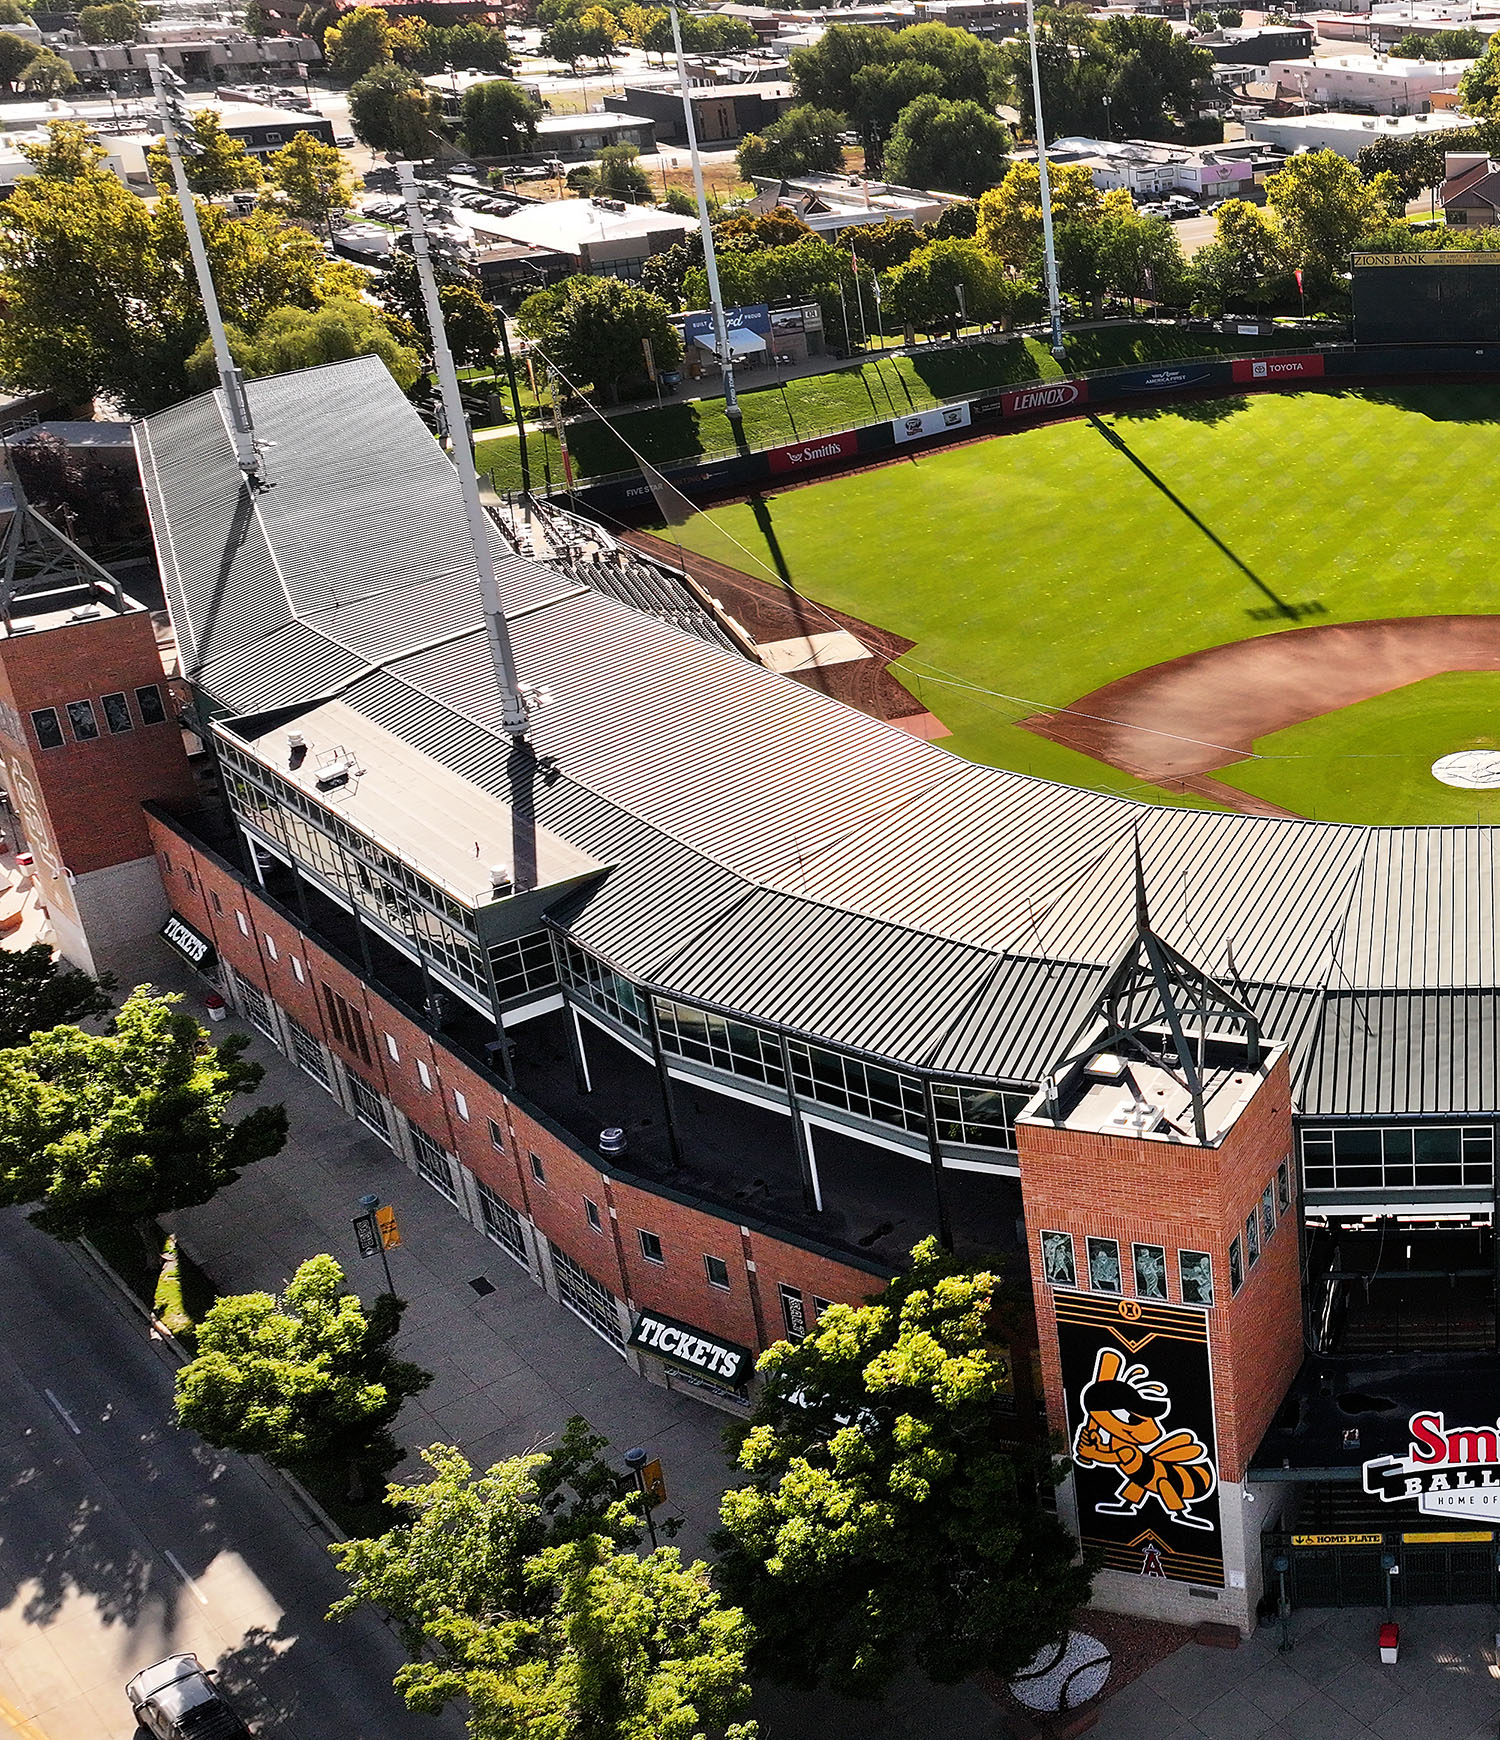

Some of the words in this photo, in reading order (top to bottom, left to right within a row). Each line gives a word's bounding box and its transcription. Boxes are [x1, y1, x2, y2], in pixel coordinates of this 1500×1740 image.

[1354, 255, 1391, 266] ZIONS
[1393, 254, 1427, 265] BANK
[1269, 362, 1303, 372] TOYOTA
[1013, 388, 1065, 411] LENNOX
[804, 442, 841, 461] Smith's
[626, 487, 643, 498] FIVE
[643, 482, 664, 494] STAR
[164, 917, 208, 962] TICKETS
[638, 1317, 741, 1378] TICKETS
[1438, 1495, 1475, 1506] HOME
[1483, 1495, 1498, 1505] OF
[1317, 1535, 1347, 1543] HOME
[1348, 1535, 1380, 1543] PLATE
